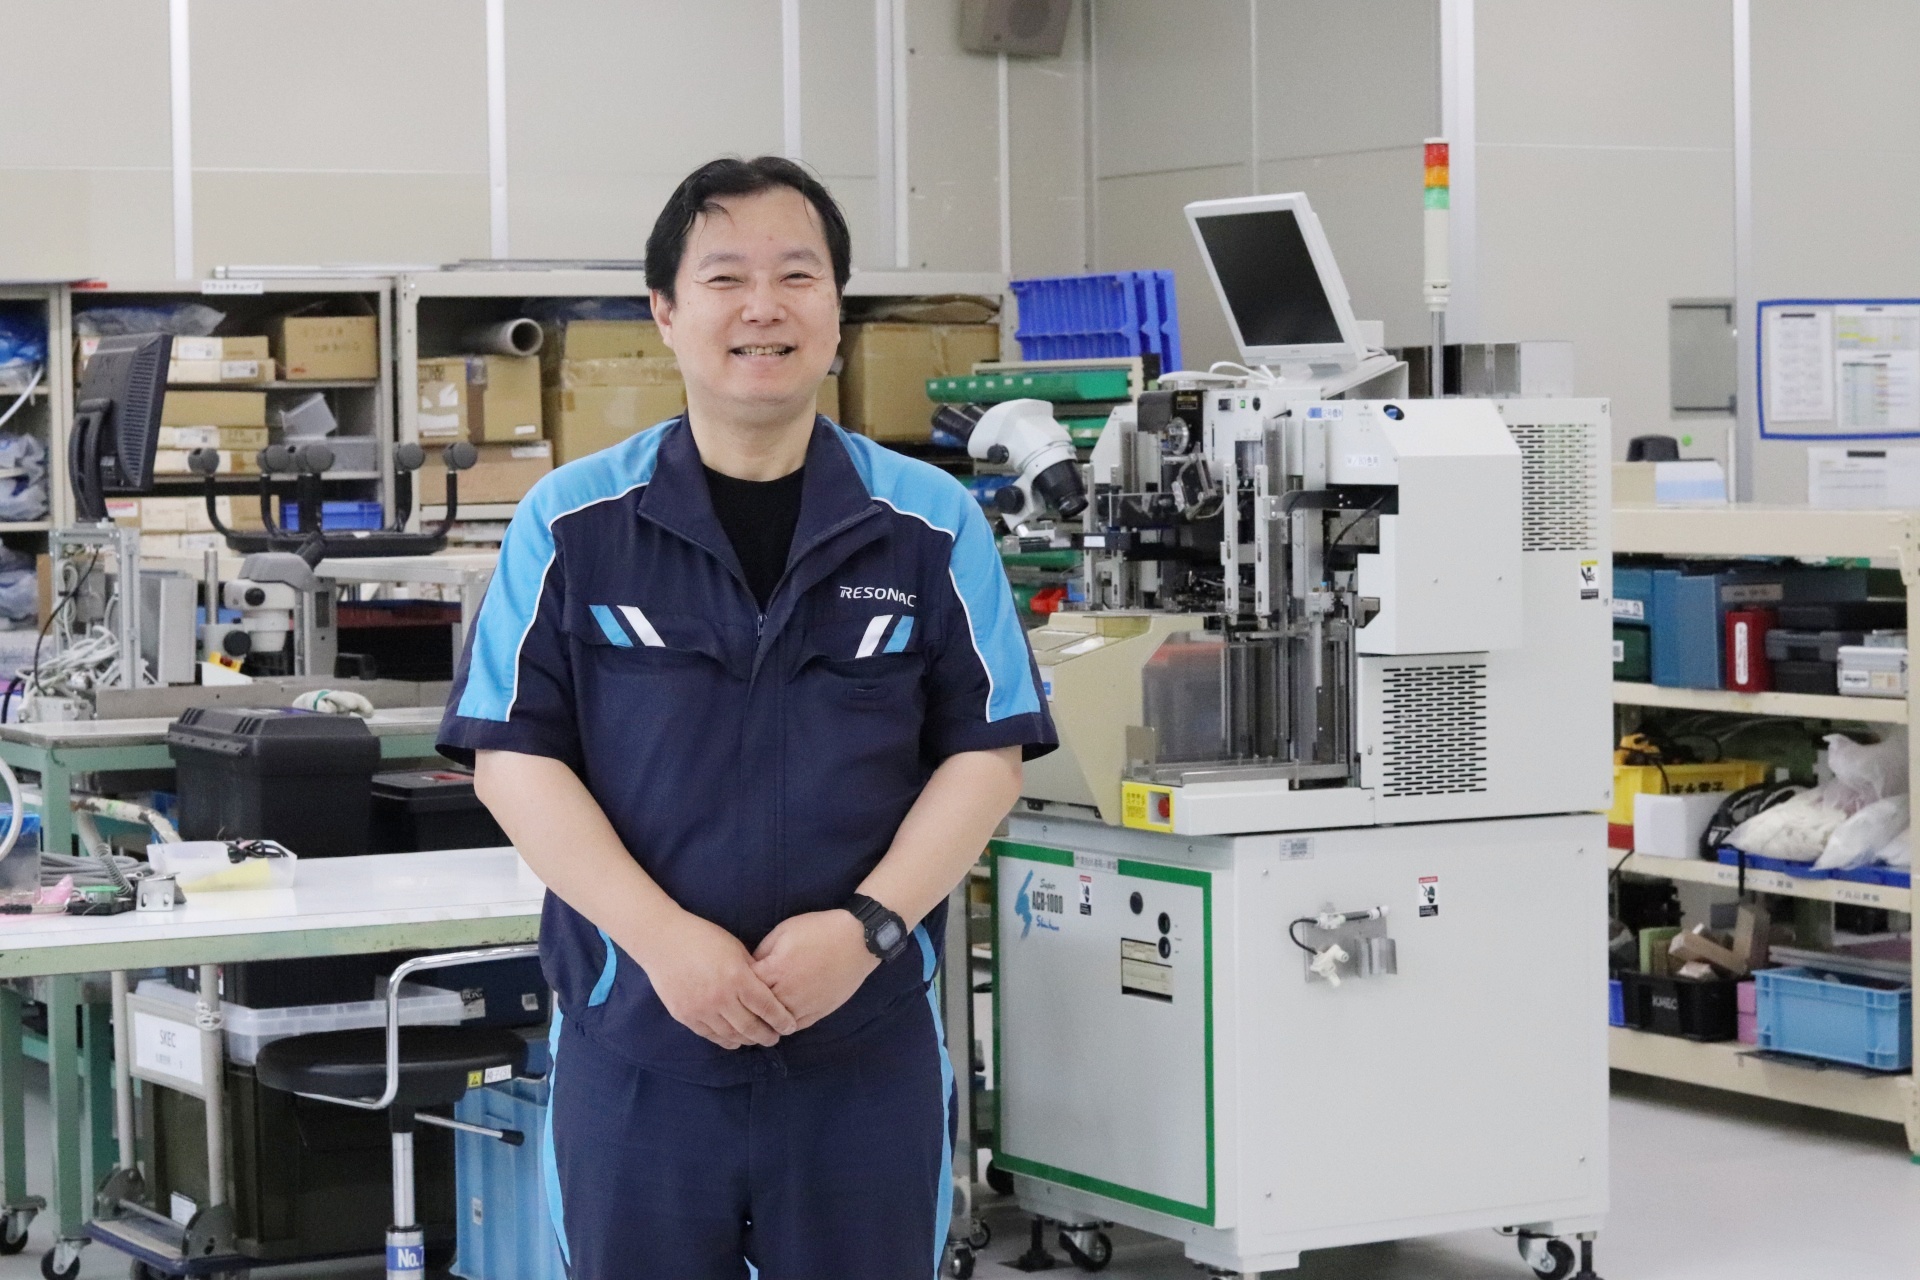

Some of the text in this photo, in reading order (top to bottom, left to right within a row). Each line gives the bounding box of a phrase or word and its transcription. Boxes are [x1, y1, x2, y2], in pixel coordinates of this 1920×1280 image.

[840, 585, 917, 608] RESONAC
[1040, 878, 1056, 890] Super
[1032, 890, 1063, 915] ACB-1000
[160, 1029, 176, 1048] SKEC
